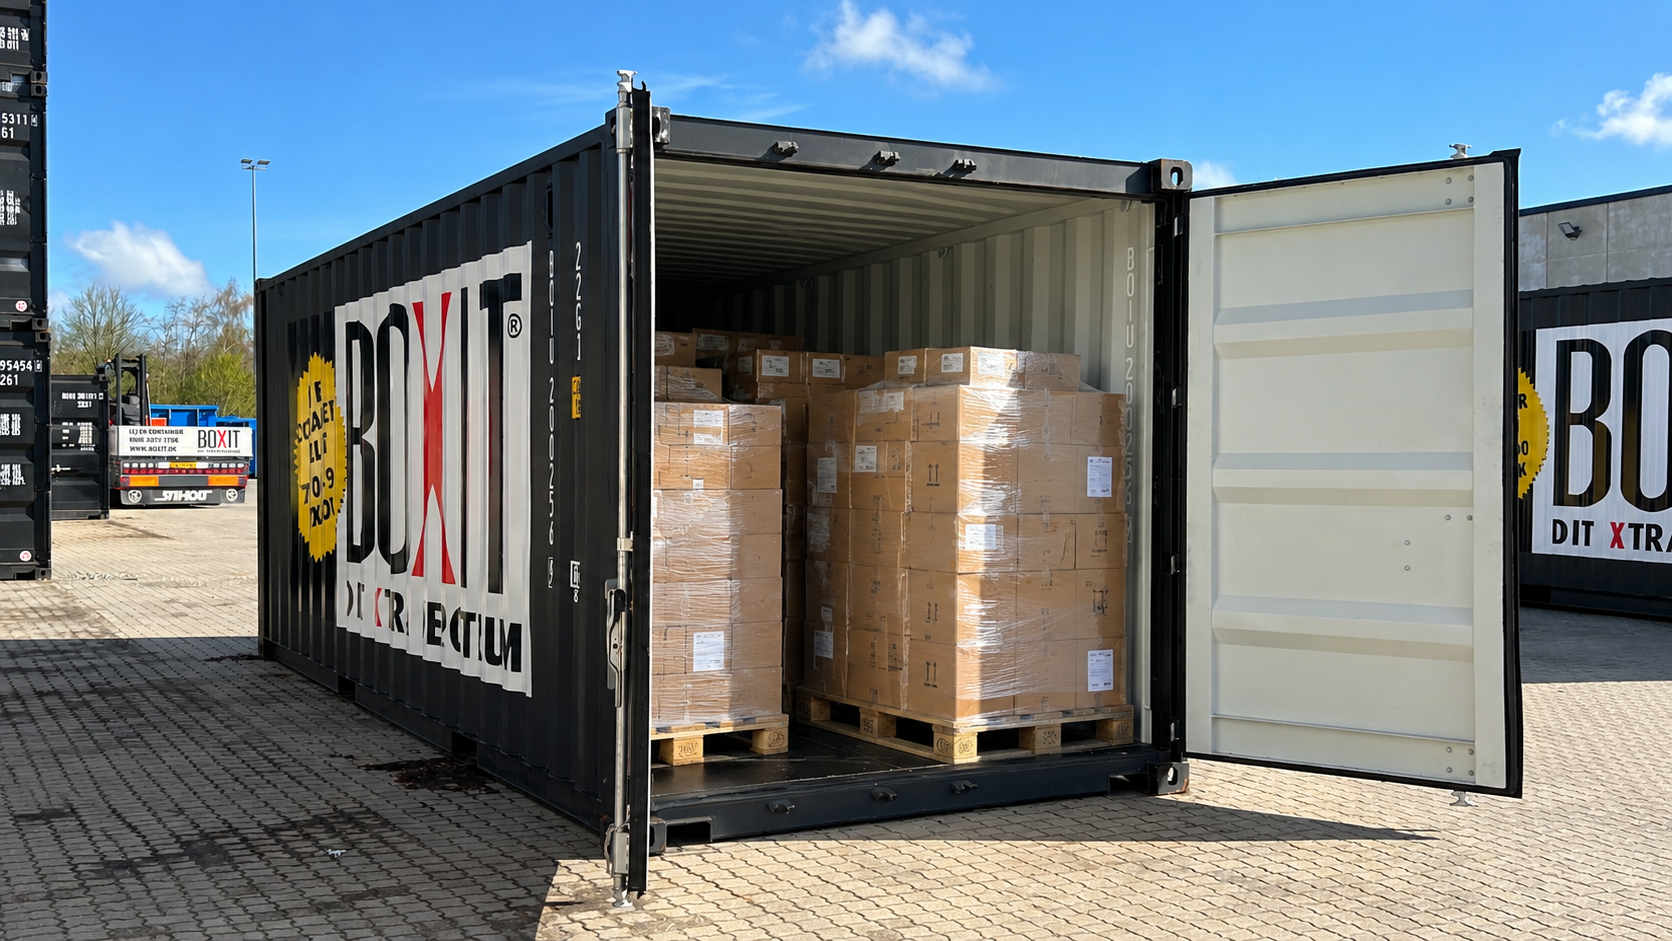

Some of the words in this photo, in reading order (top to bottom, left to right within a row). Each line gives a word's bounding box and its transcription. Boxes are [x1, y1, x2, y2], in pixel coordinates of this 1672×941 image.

[1126, 247, 1135, 348] BOIU
[197, 429, 240, 449] BOXIT
[345, 272, 522, 595] BOXIT
[1552, 518, 1595, 546] DIT
